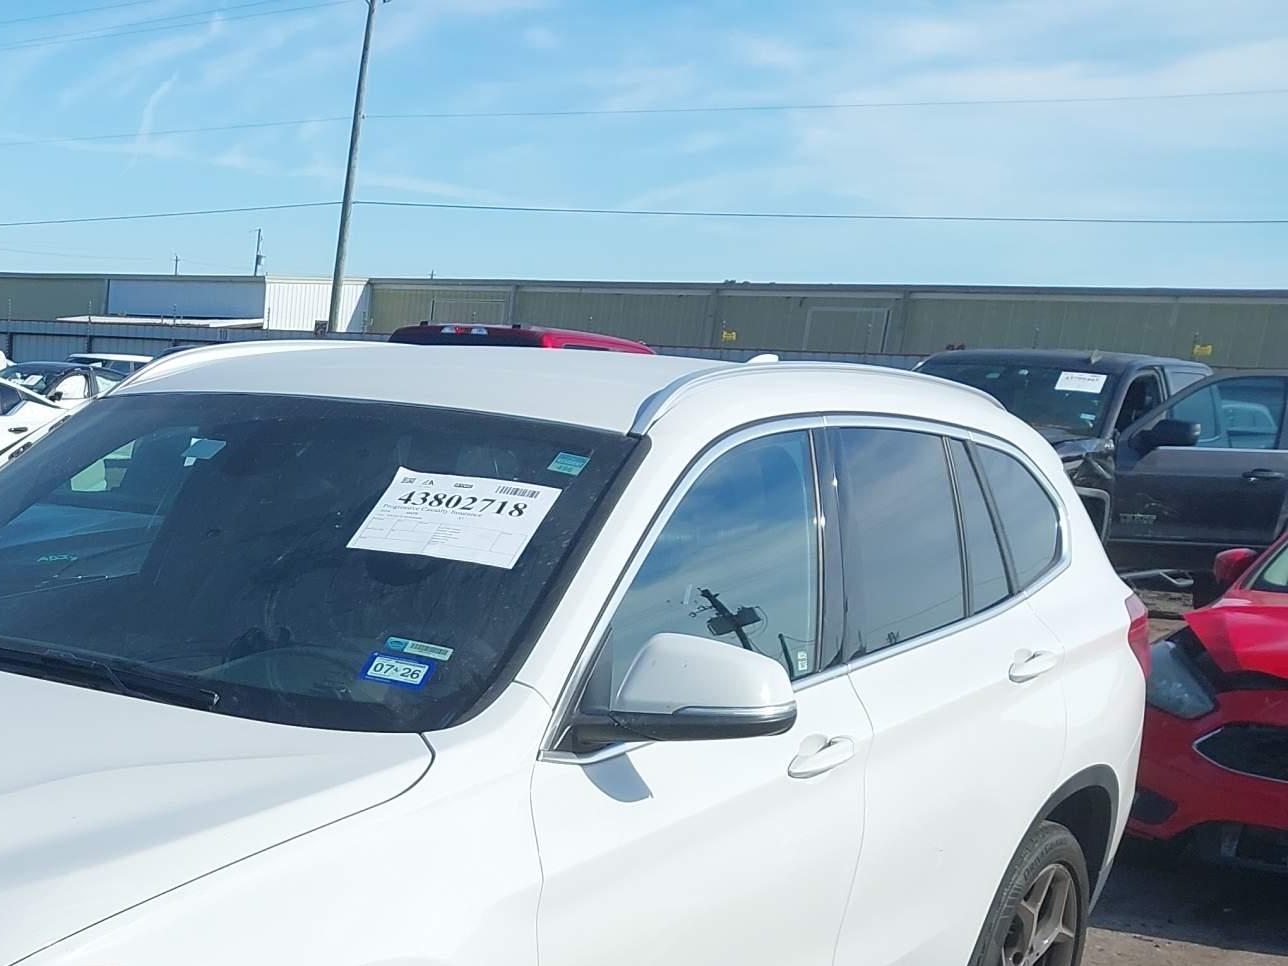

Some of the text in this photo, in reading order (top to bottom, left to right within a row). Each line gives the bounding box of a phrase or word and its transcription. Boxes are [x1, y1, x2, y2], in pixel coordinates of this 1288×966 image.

[397, 490, 528, 518] 43802718
[373, 662, 395, 675] 07
[399, 667, 422, 680] 26
